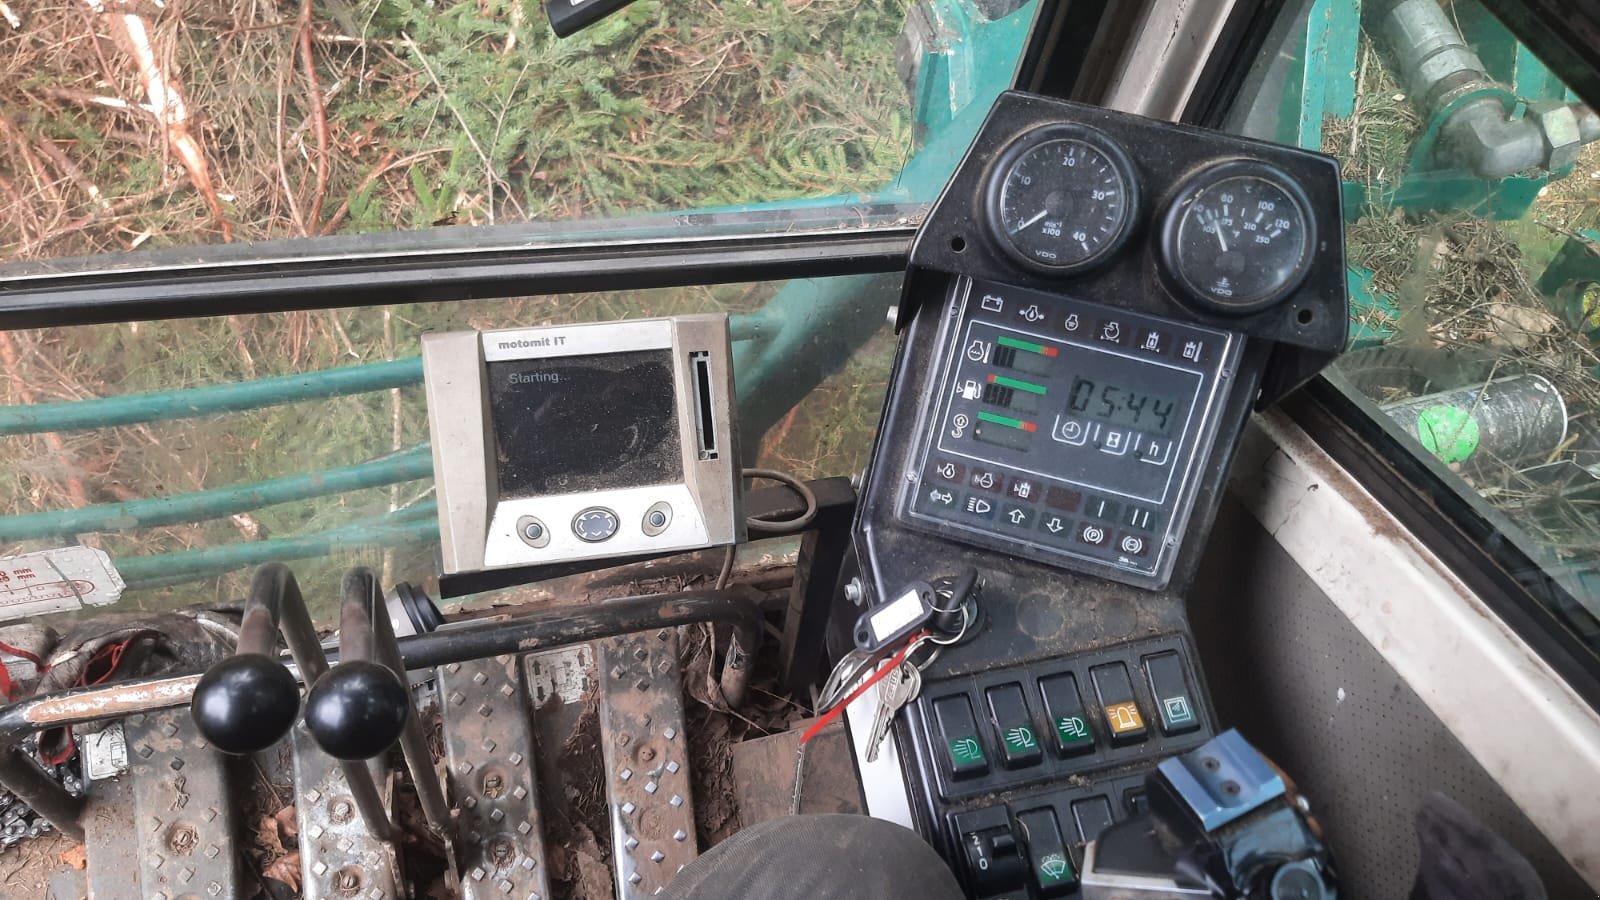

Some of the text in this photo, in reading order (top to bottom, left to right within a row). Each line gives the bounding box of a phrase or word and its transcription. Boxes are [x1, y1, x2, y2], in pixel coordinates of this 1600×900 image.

[1062, 157, 1075, 166] 20
[1020, 175, 1031, 185] 10
[1092, 190, 1105, 200] 30
[1258, 201, 1275, 211] 100
[1243, 222, 1256, 231] 210
[1275, 219, 1290, 229] 120
[1073, 231, 1086, 242] 40
[1255, 235, 1270, 244] 250
[1035, 250, 1057, 259] VDO
[1210, 287, 1233, 296] VDO
[498, 336, 566, 349] motomit IT
[1070, 379, 1174, 429] 05:44
[972, 835, 988, 870] 2 1 0
